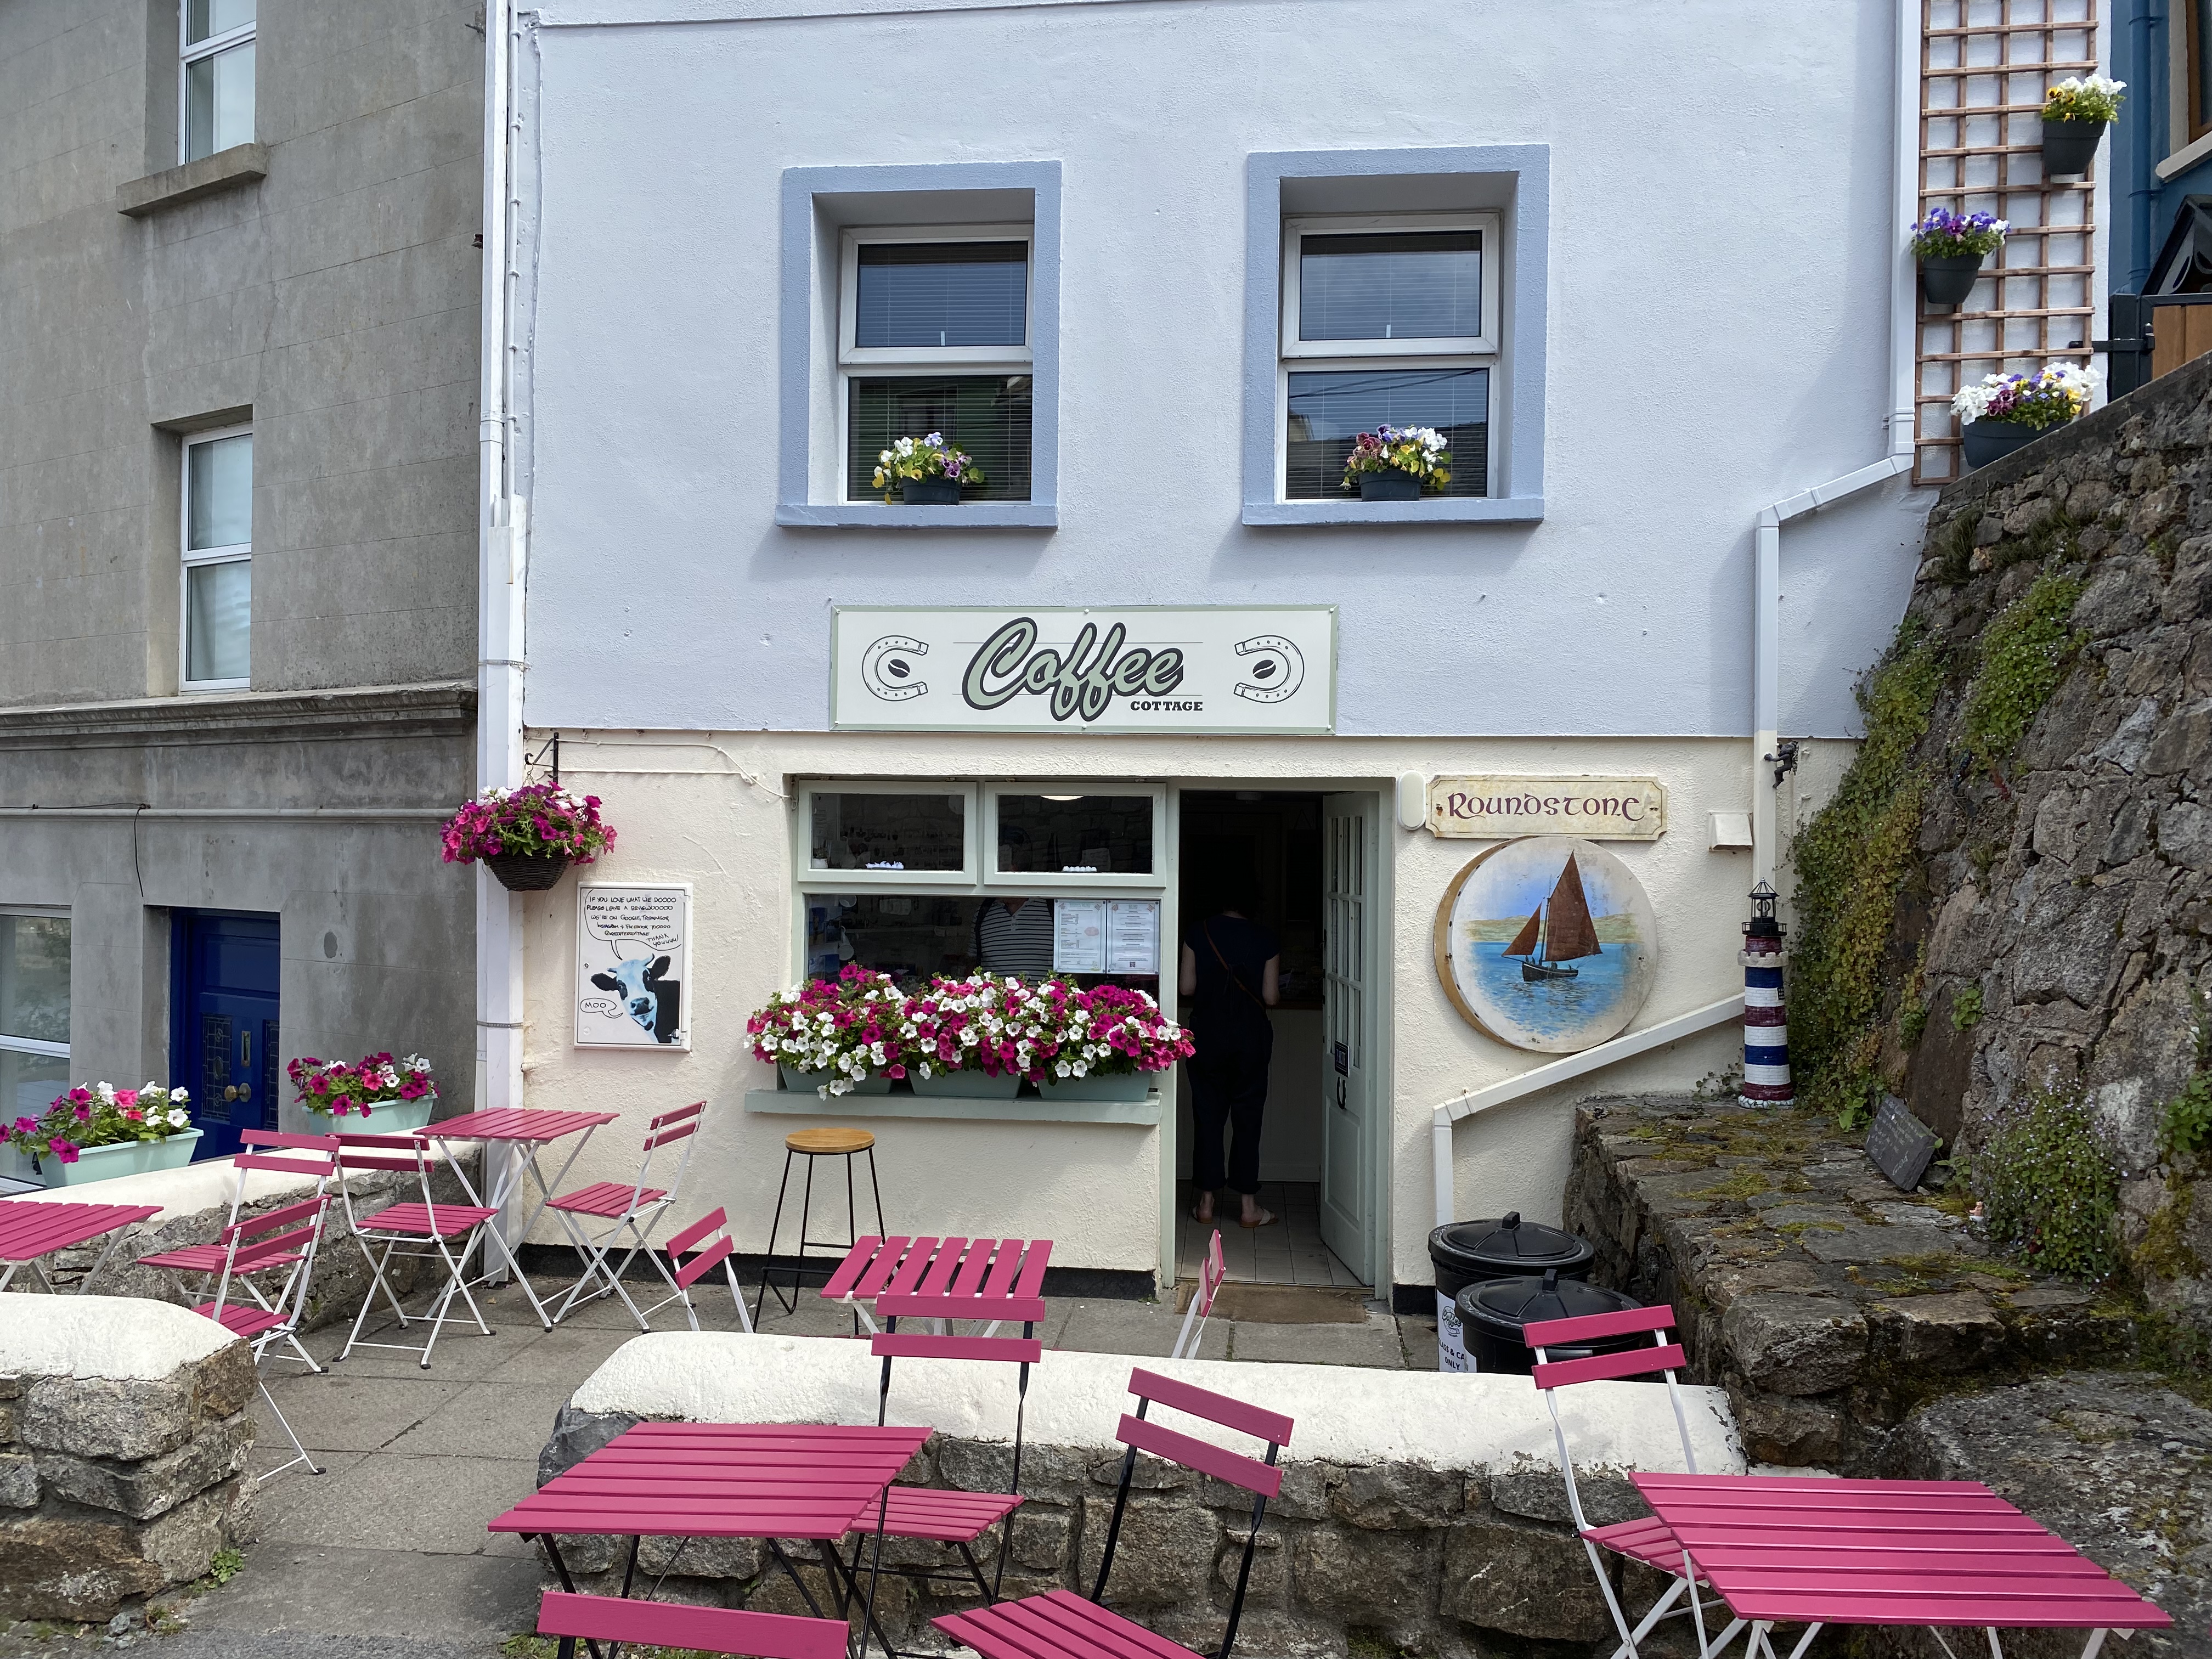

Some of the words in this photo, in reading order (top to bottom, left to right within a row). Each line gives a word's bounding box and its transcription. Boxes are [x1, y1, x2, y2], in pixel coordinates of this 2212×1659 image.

[962, 617, 1184, 721] Coffee
[1130, 701, 1203, 711] COTTAGE
[646, 933, 669, 942] THANK
[1450, 1348, 1455, 1357] &
[1444, 1356, 1460, 1371] ONLY
